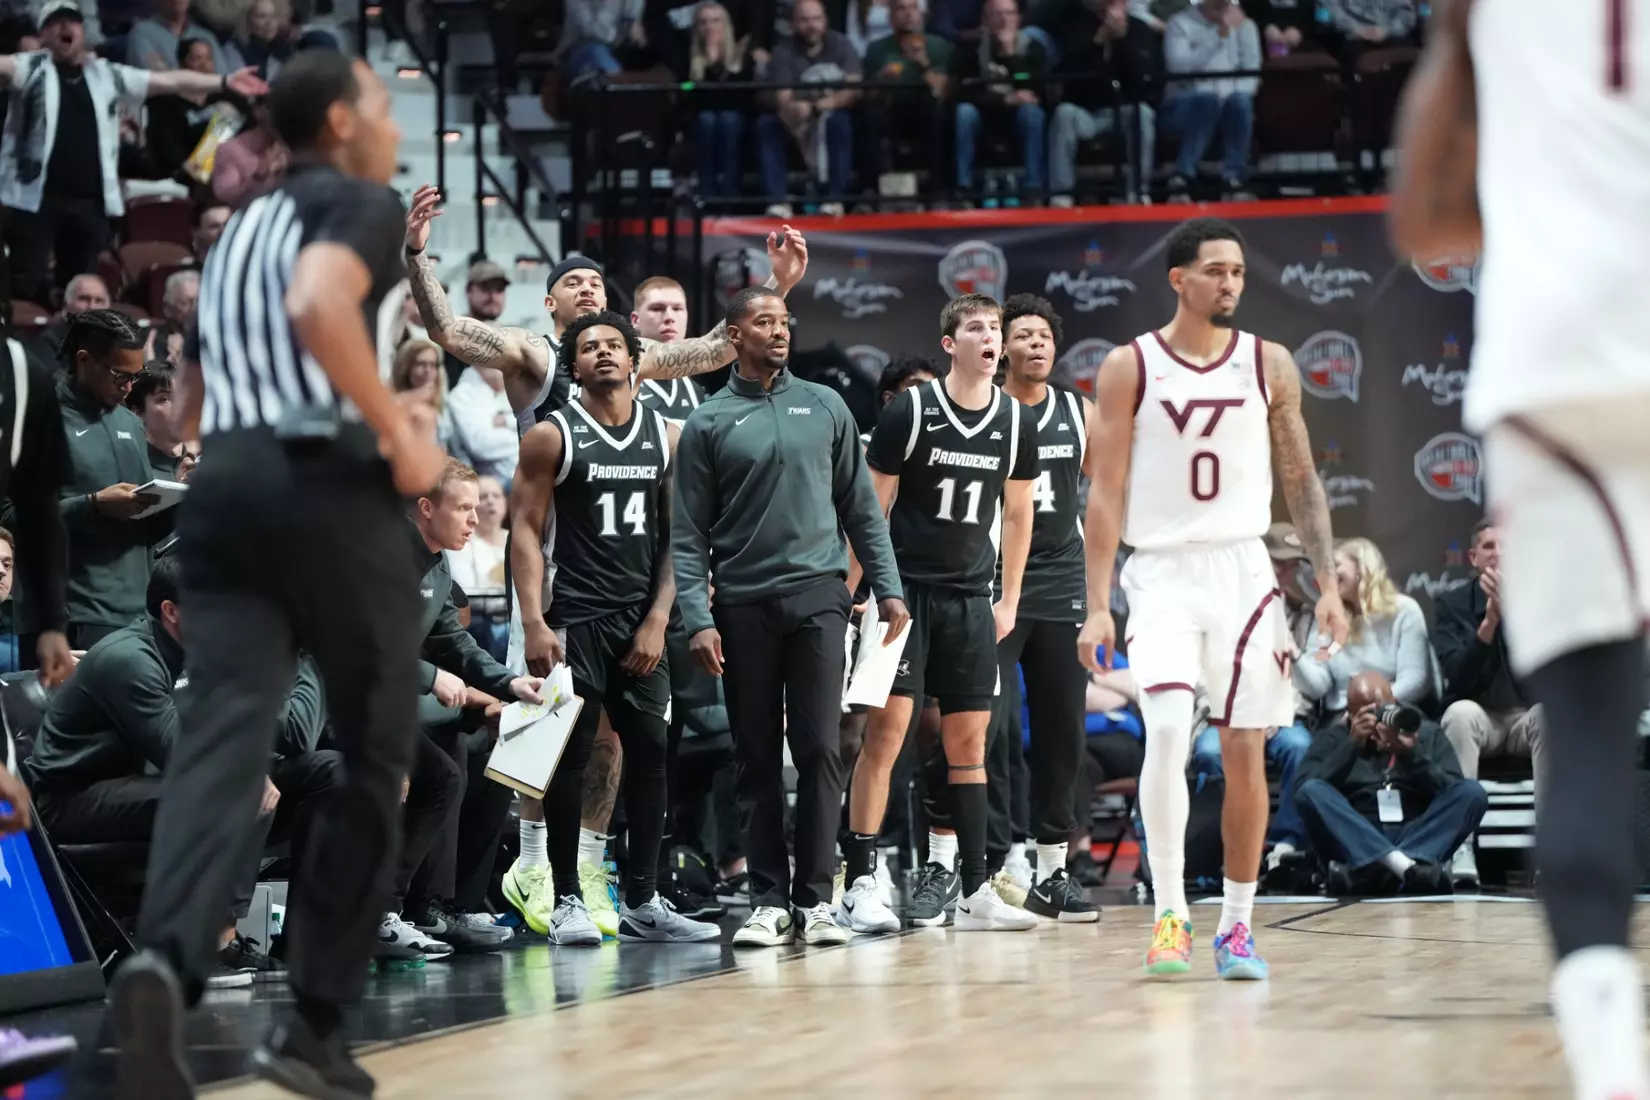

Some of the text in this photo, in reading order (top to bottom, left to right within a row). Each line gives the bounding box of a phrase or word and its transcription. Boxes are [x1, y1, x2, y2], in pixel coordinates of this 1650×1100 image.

[927, 447, 1001, 471] PROVIDENCE
[1037, 445, 1074, 460] DENCE
[585, 462, 658, 482] PROVIDENCE
[1190, 450, 1221, 502] 0
[594, 490, 648, 537] 14
[934, 477, 984, 525] 11
